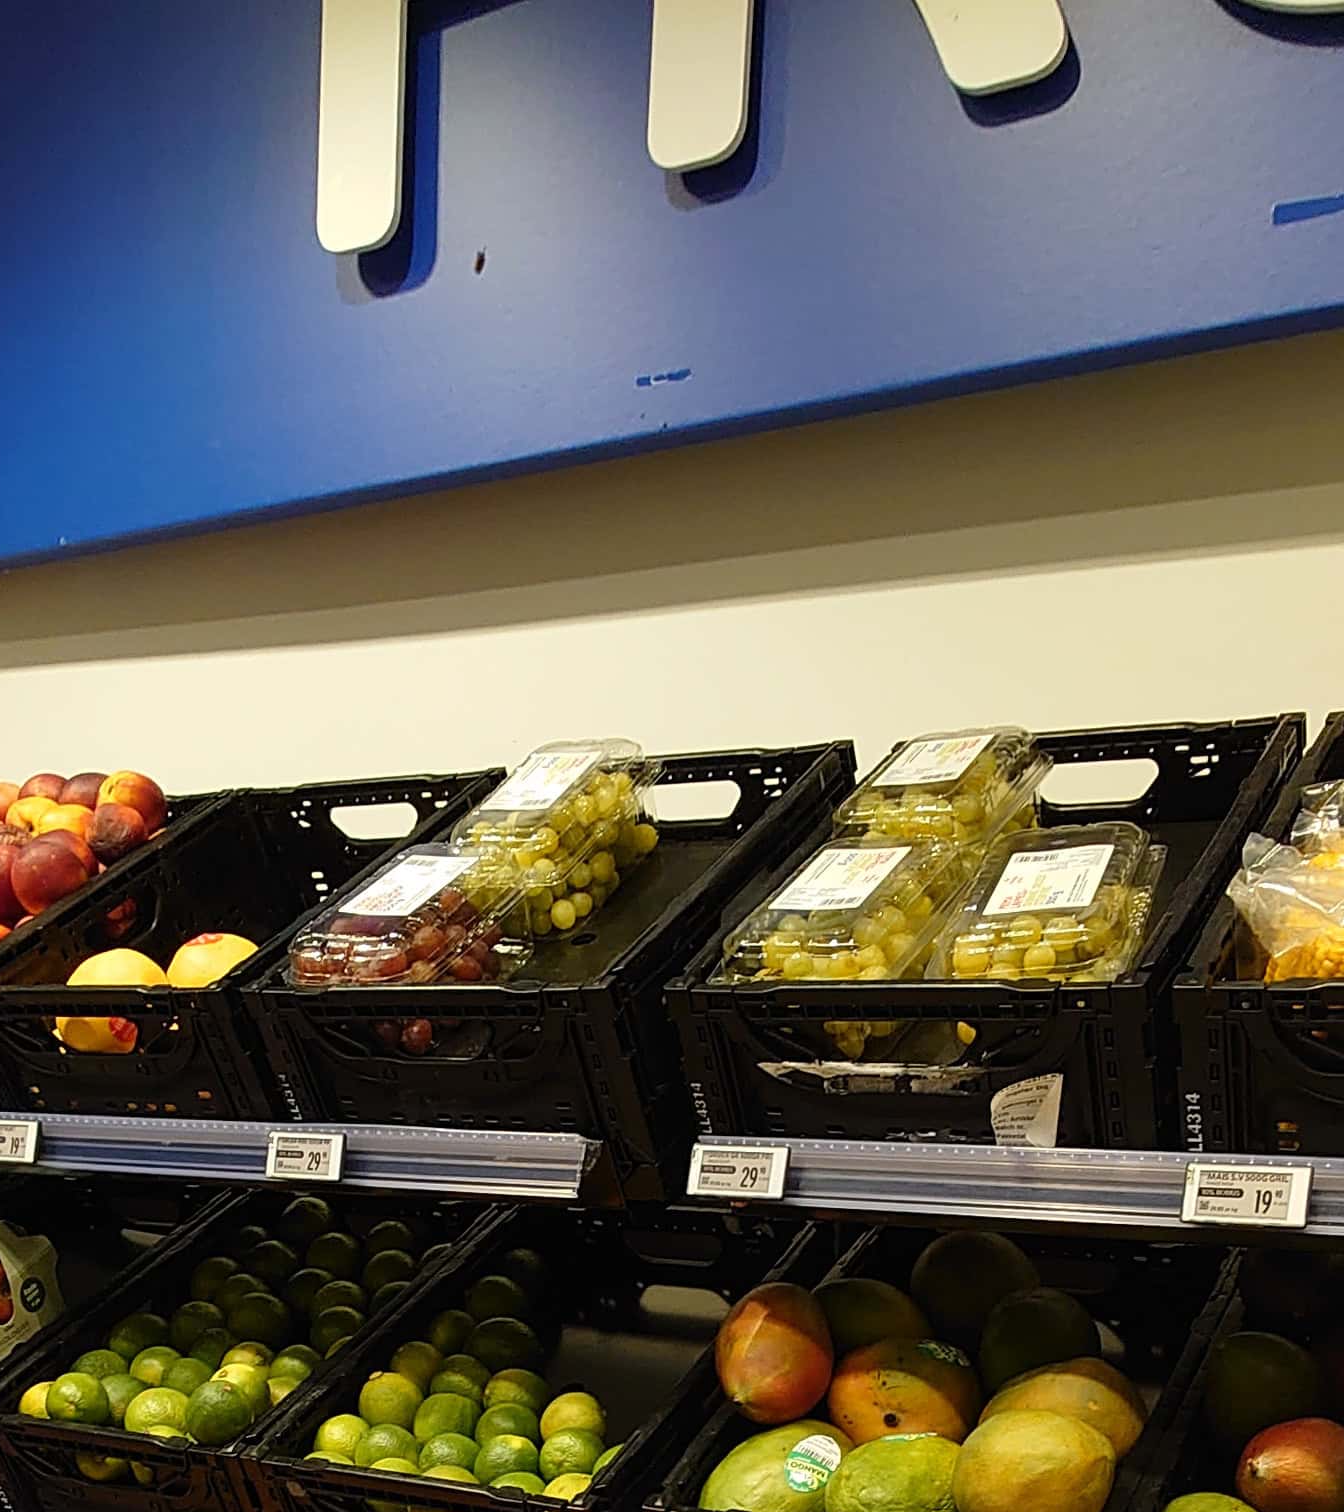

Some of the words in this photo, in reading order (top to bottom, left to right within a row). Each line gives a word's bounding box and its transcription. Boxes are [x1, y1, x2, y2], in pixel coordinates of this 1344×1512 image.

[1185, 1092, 1204, 1152] LL4314
[307, 1151, 321, 1171] 29
[740, 1166, 758, 1188] 29
[1254, 1189, 1272, 1214] 19
[790, 1461, 826, 1478] MANGO
